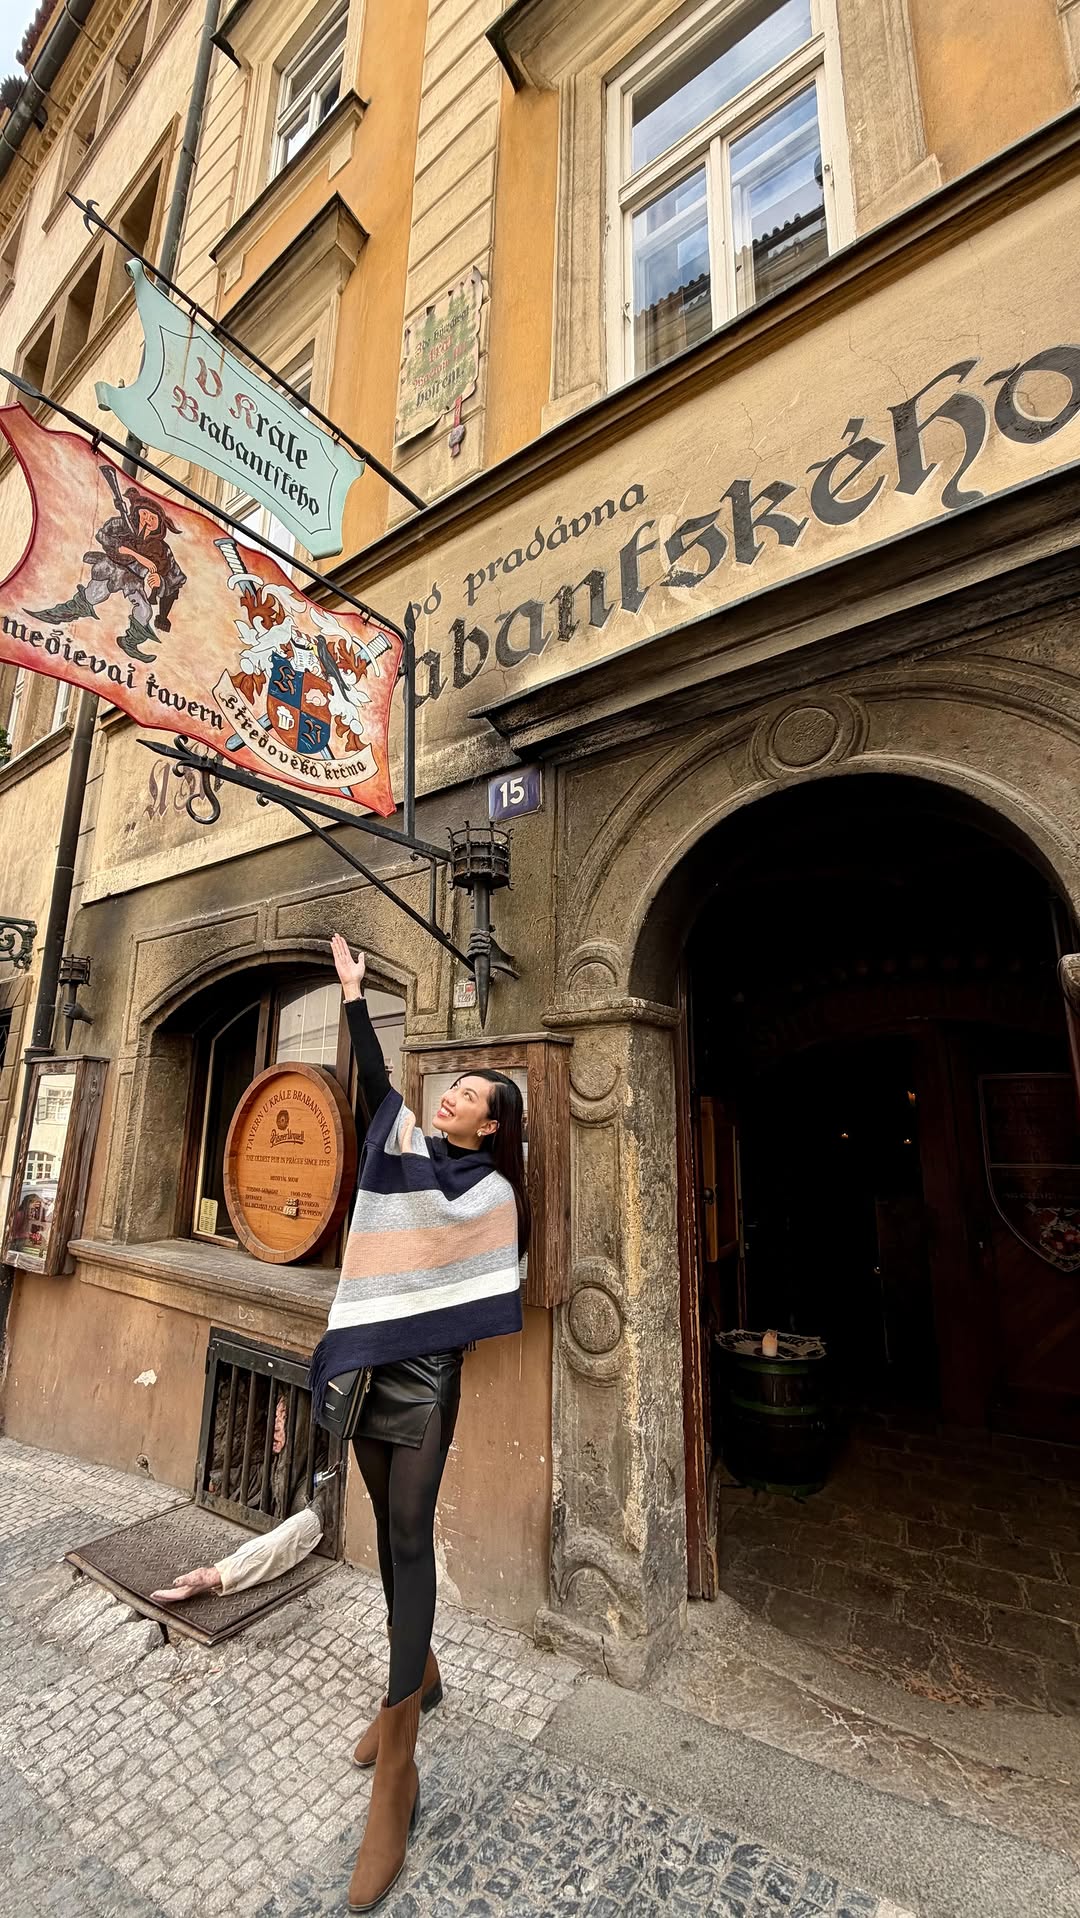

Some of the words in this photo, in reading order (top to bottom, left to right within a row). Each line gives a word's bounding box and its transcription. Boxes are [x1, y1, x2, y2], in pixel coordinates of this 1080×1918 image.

[228, 392, 309, 470] Krále
[463, 483, 649, 607] pradávna
[146, 673, 225, 730] tavern
[499, 776, 525, 809] 15
[246, 1111, 264, 1151] TAVERN
[262, 1103, 269, 1113] U
[268, 1089, 292, 1108] KRÁLE
[292, 1089, 332, 1155] BRABANTSKÉHO
[303, 1158, 318, 1166] SINCE
